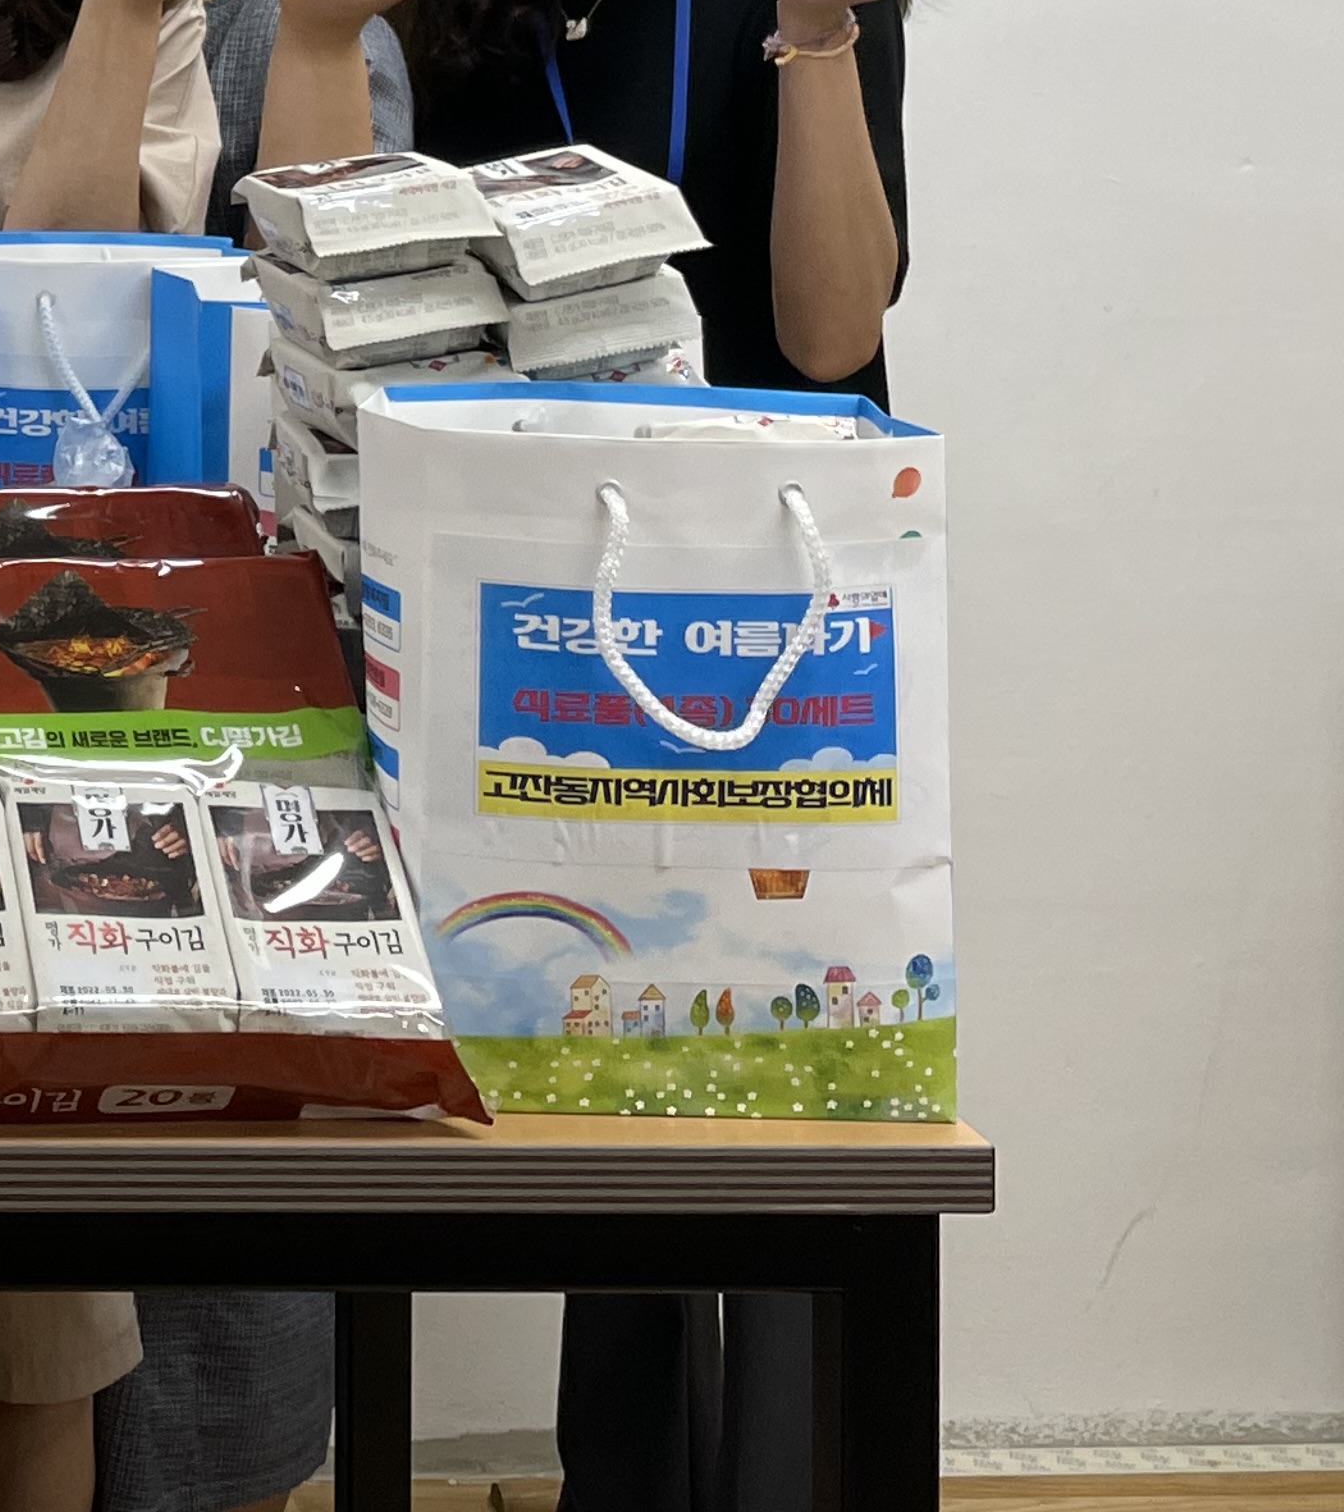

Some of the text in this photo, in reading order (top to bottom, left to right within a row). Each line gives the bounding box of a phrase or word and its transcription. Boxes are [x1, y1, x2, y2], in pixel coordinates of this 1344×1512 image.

[513, 612, 664, 657] 건강한
[745, 693, 877, 727] 0세트
[71, 729, 129, 750] 새로운
[200, 723, 305, 750] CJ명가김
[483, 770, 894, 809] 고잔동지역사회보장협의체
[275, 798, 309, 844] 명가
[44, 920, 206, 956] 명가 직화구이김
[264, 925, 404, 960] 직화구이김
